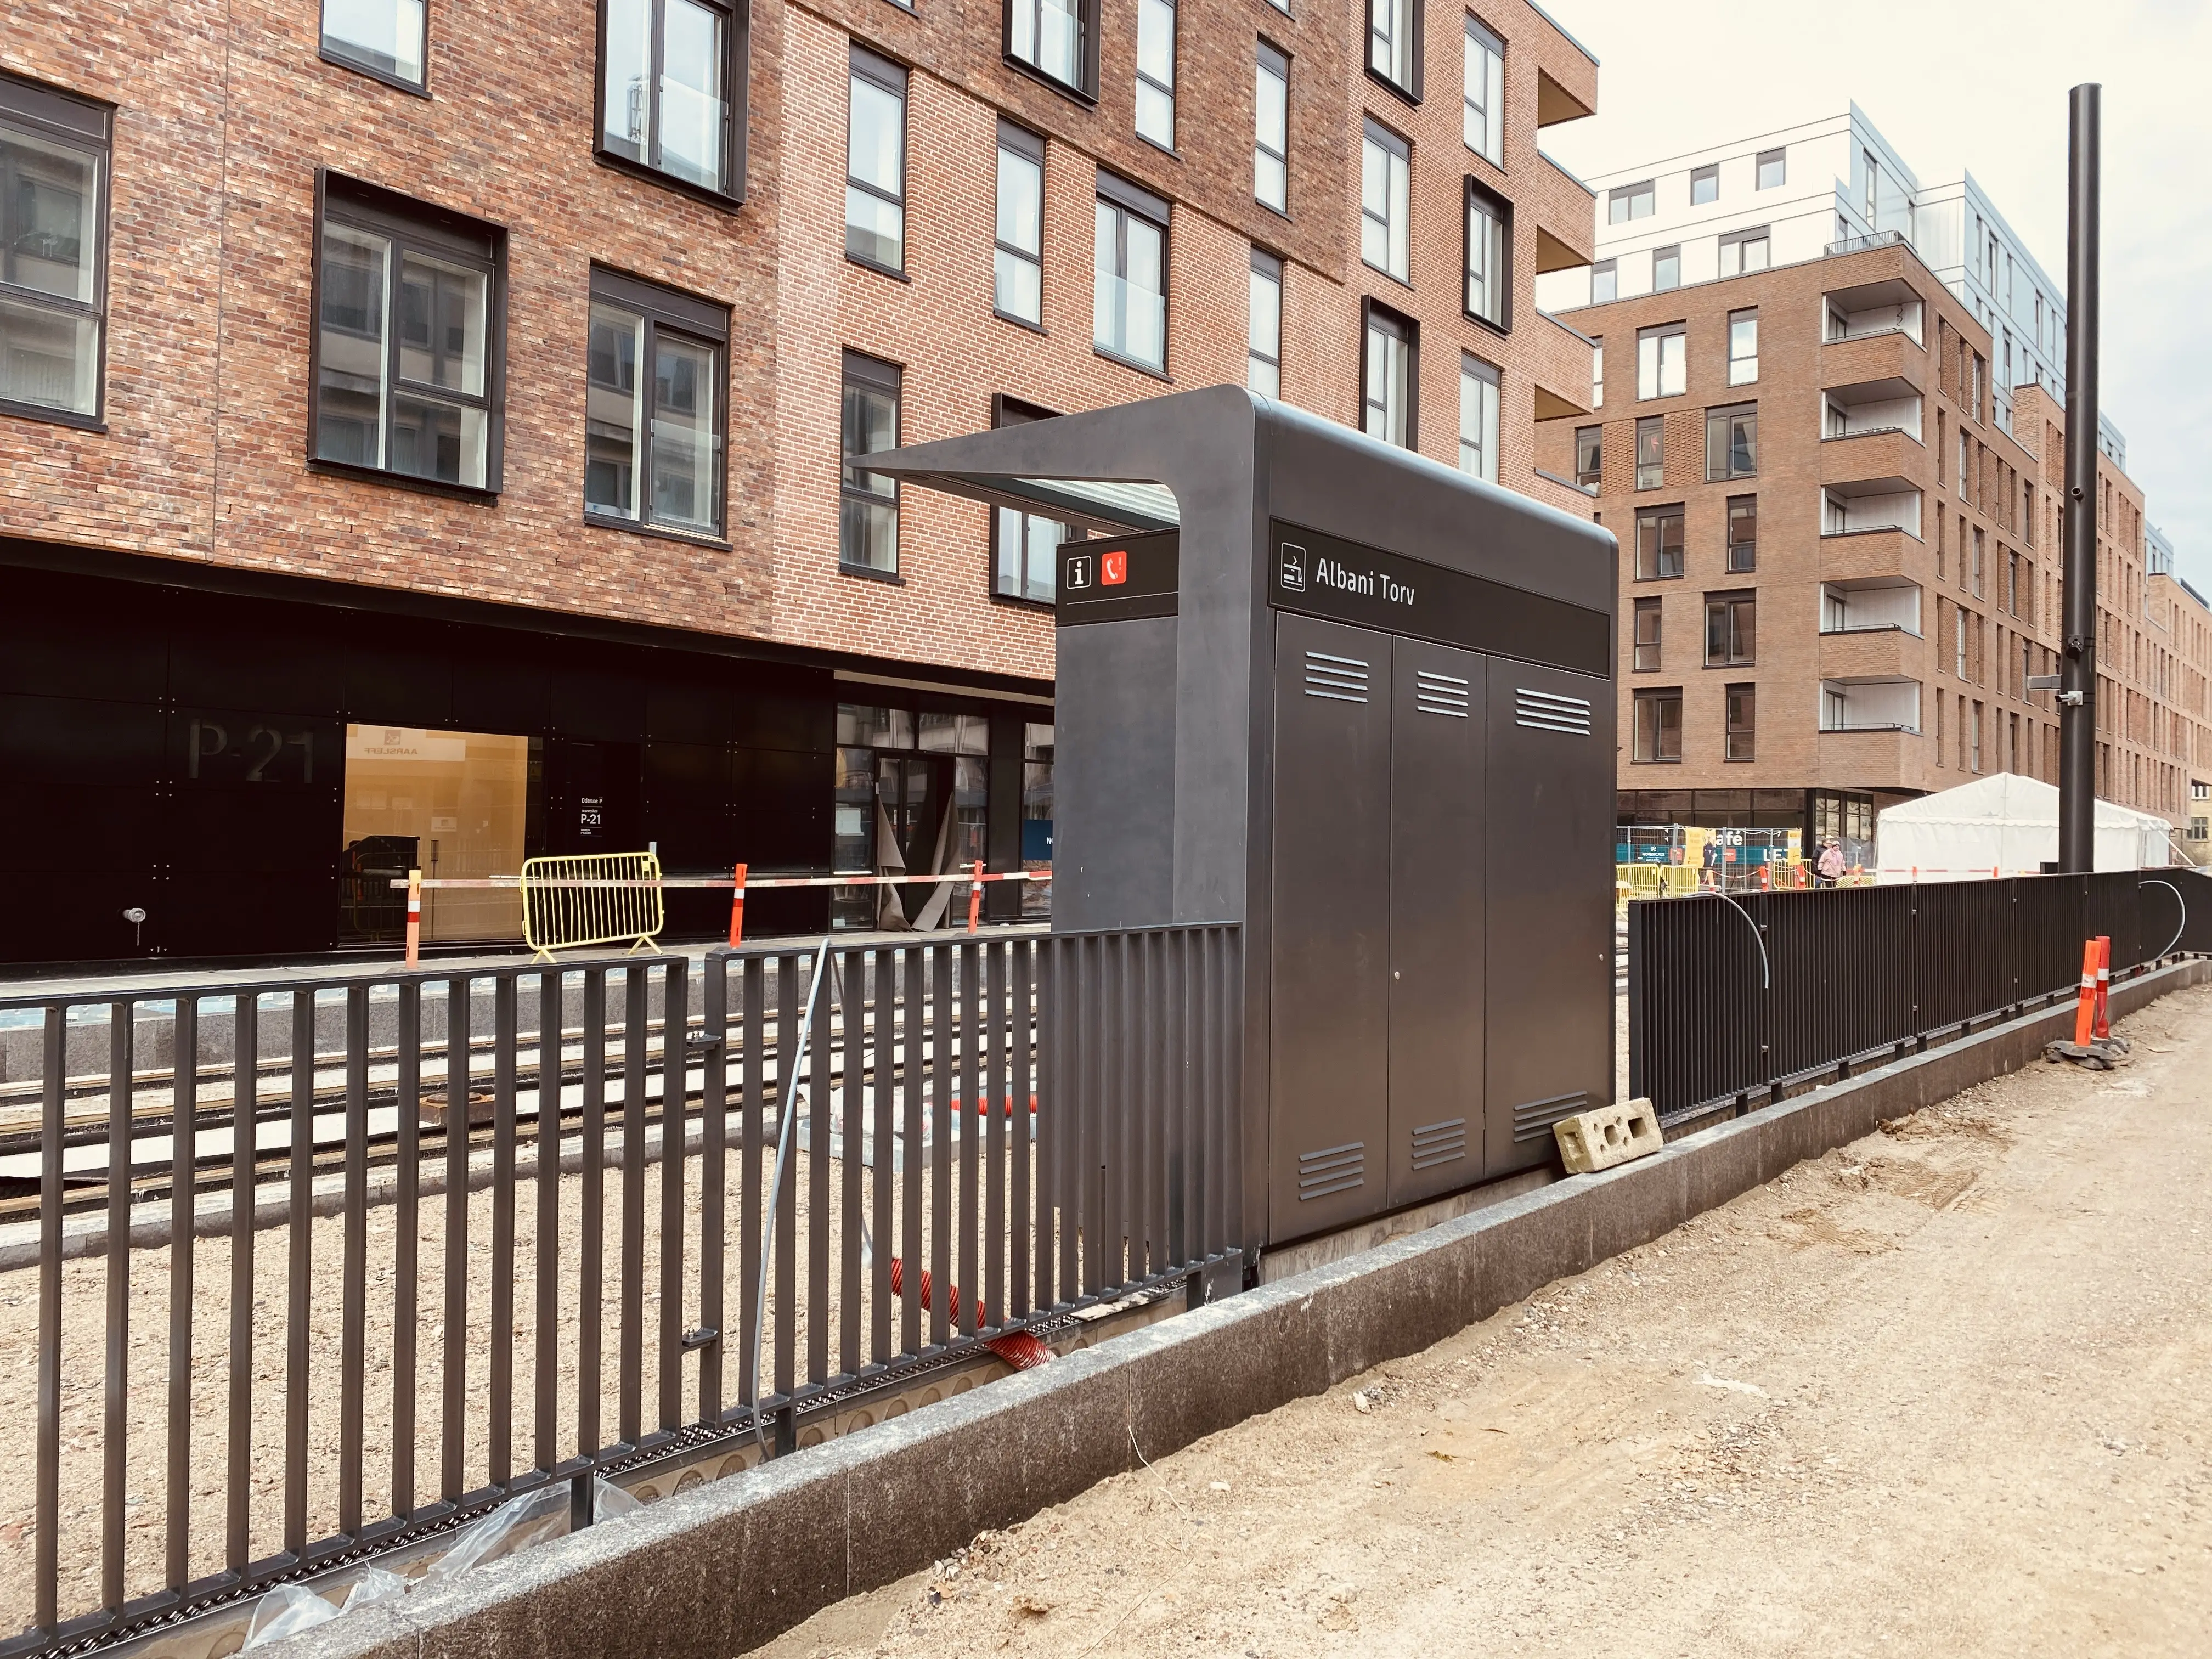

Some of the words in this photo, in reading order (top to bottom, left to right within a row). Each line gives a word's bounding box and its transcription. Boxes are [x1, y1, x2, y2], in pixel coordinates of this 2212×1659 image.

[1316, 557, 1374, 595] Albani
[1380, 572, 1415, 606] Torv
[188, 718, 314, 784] P-21
[580, 814, 601, 825] P-21
[1713, 830, 1743, 846] afé
